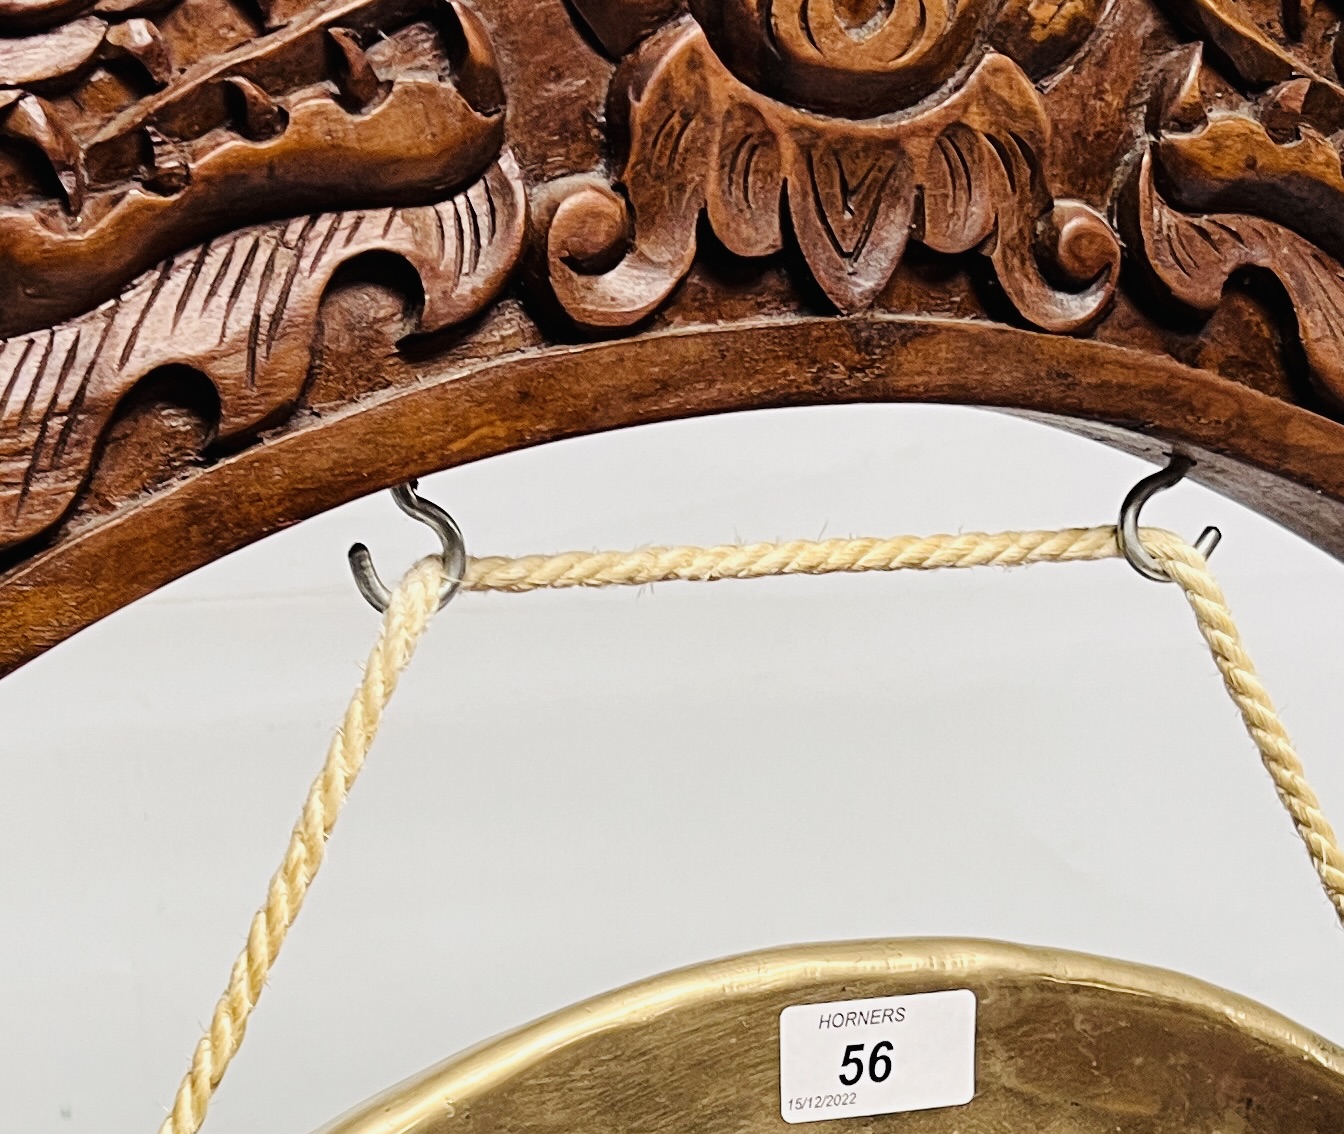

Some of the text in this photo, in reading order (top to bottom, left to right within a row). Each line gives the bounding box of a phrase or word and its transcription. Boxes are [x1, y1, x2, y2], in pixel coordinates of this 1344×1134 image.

[818, 1007, 906, 1030] HORNERS
[839, 1040, 894, 1086] 56
[788, 1092, 857, 1111] 15/12/2022
